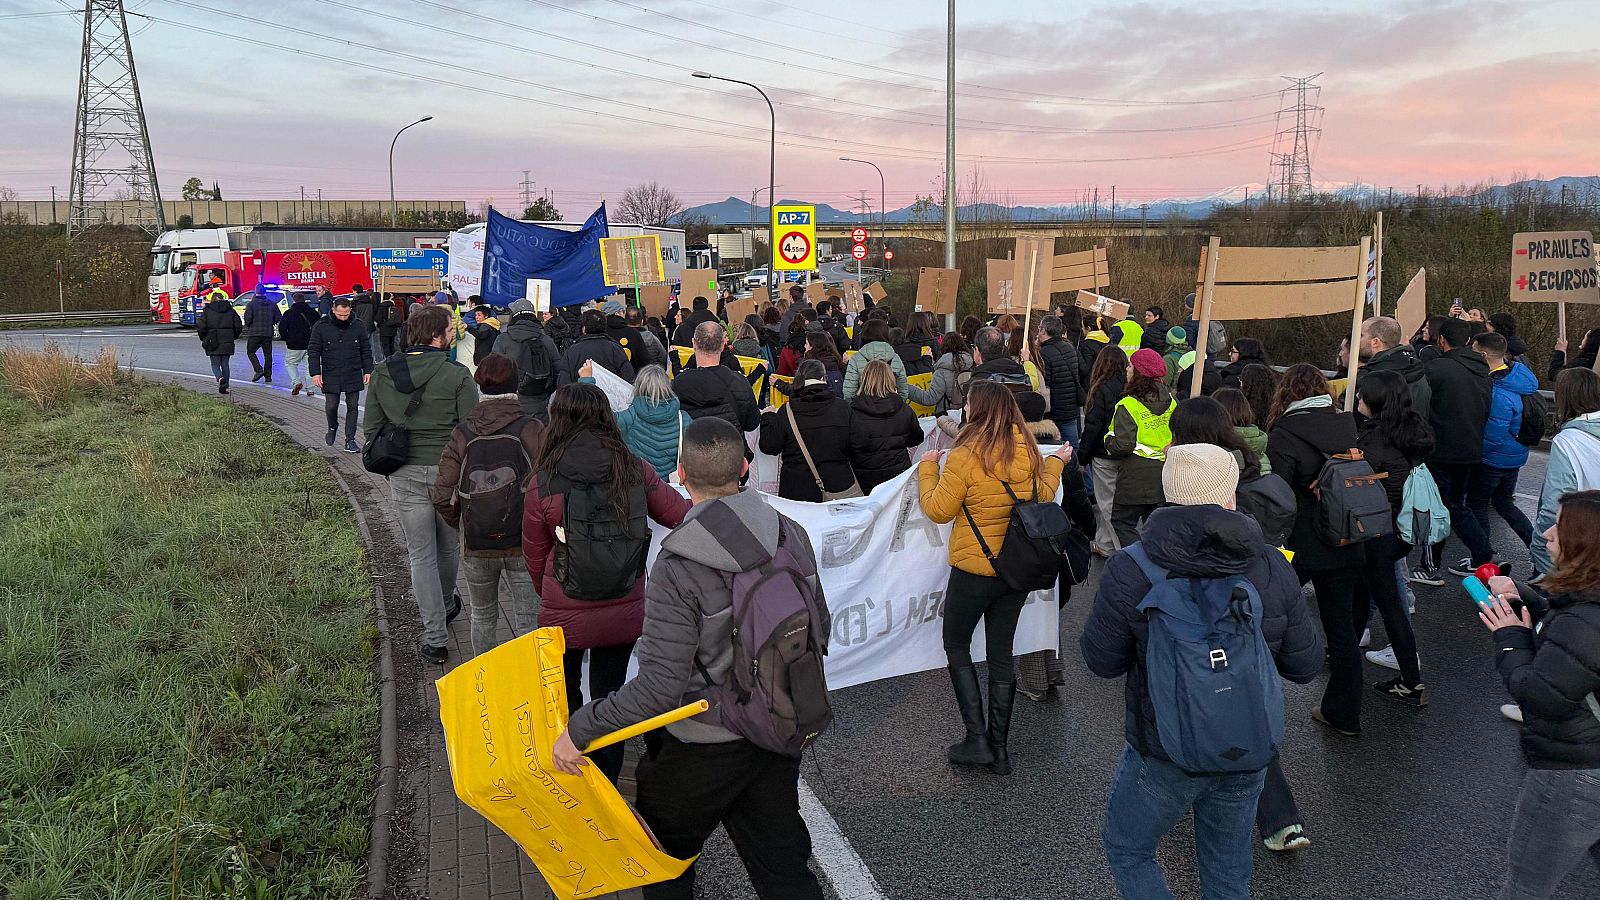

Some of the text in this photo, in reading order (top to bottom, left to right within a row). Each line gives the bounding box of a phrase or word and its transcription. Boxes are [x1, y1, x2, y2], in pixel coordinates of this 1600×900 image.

[780, 213, 809, 224] AP-7
[1528, 238, 1590, 260] PARAULES
[287, 271, 327, 280] ESTRELLA
[1528, 268, 1597, 291] RECURSOS
[490, 778, 516, 802] les
[581, 816, 620, 842] per
[554, 860, 605, 896] No
